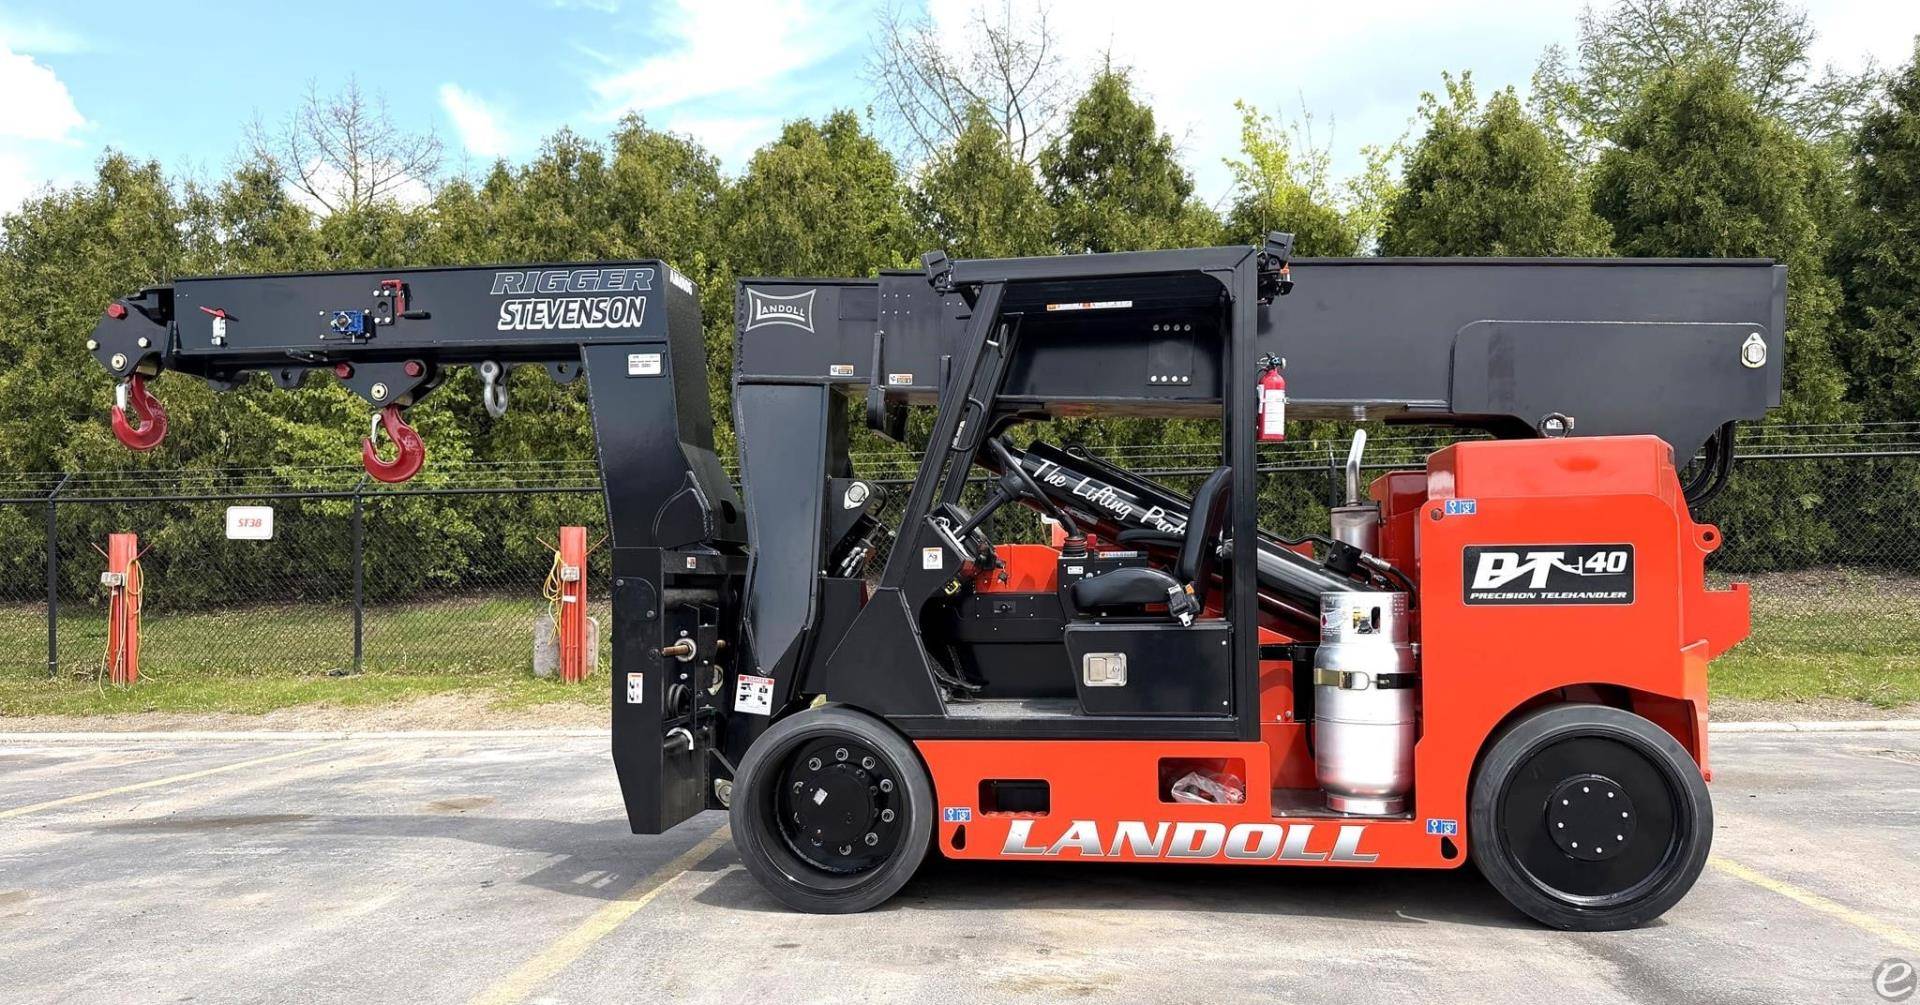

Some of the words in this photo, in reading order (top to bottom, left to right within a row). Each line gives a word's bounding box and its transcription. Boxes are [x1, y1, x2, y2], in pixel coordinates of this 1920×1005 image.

[490, 268, 654, 295] RIGGER
[497, 296, 646, 330] STEVENSON
[756, 299, 805, 322] LANDOLL
[1033, 458, 1066, 487] The
[1073, 477, 1133, 520] Lifting
[1470, 592, 1536, 600] PRECISION
[1541, 591, 1627, 599] TELEHANDLER
[1000, 819, 1379, 862] LANDOLL
